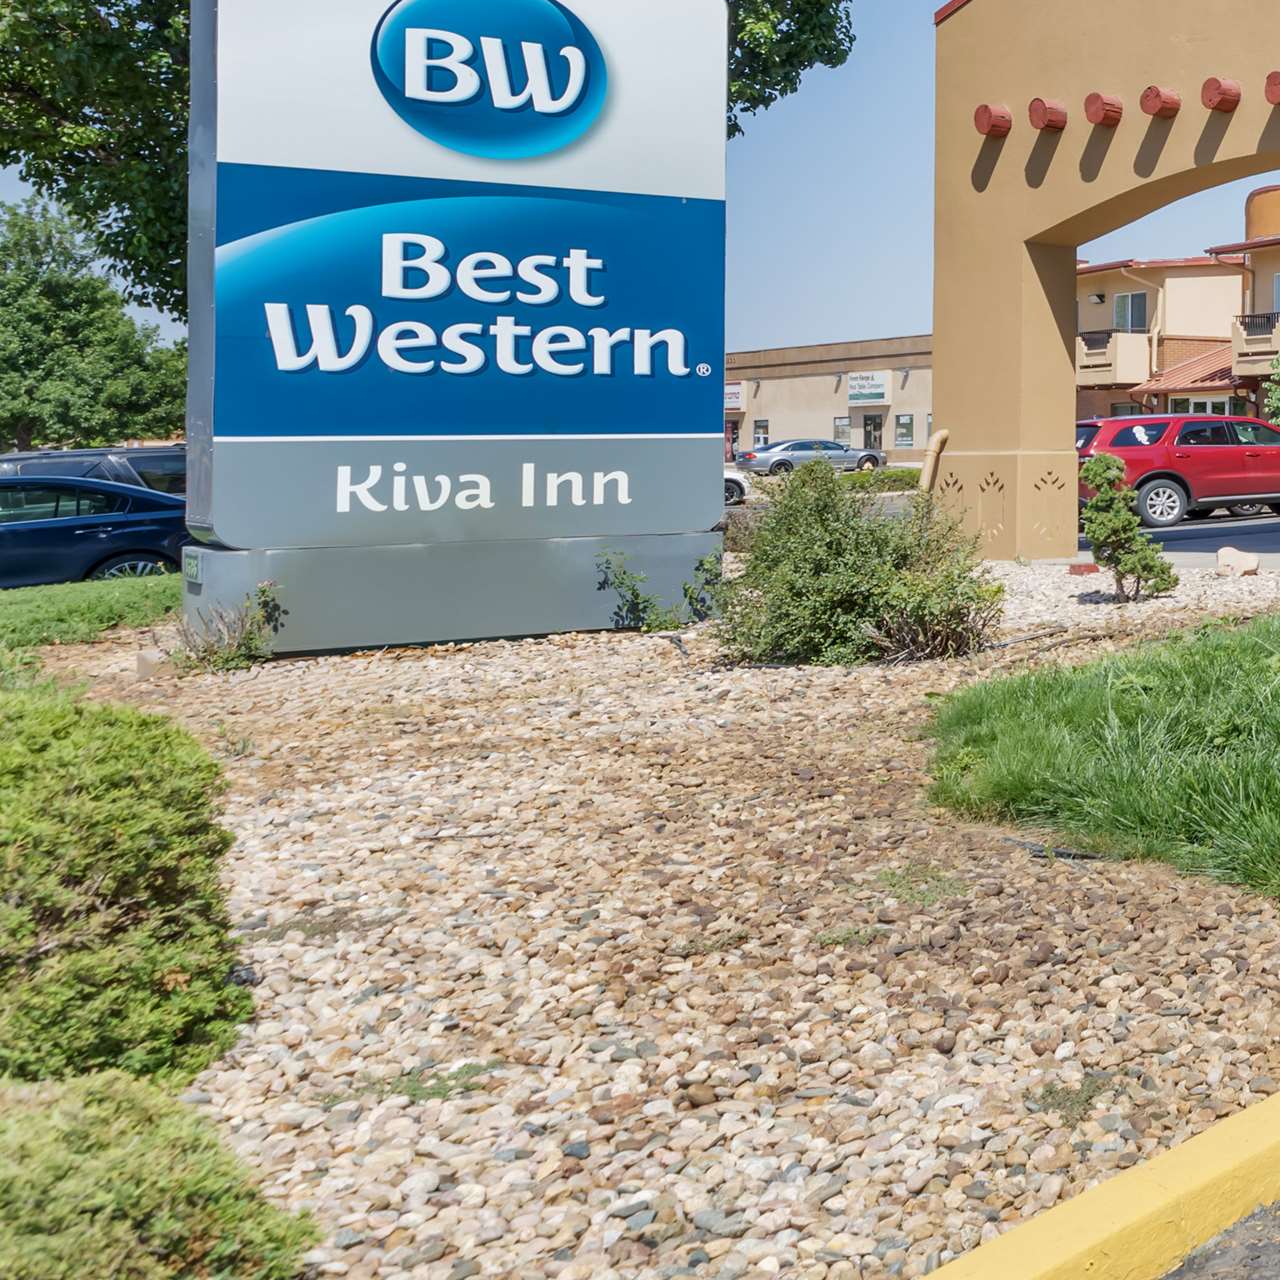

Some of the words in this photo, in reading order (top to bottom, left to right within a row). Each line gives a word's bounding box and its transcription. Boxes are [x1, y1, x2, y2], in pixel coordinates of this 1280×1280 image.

[404, 27, 586, 114] BW
[381, 232, 606, 307] Best
[336, 462, 496, 513] Kiva
[521, 462, 633, 508] Inn
